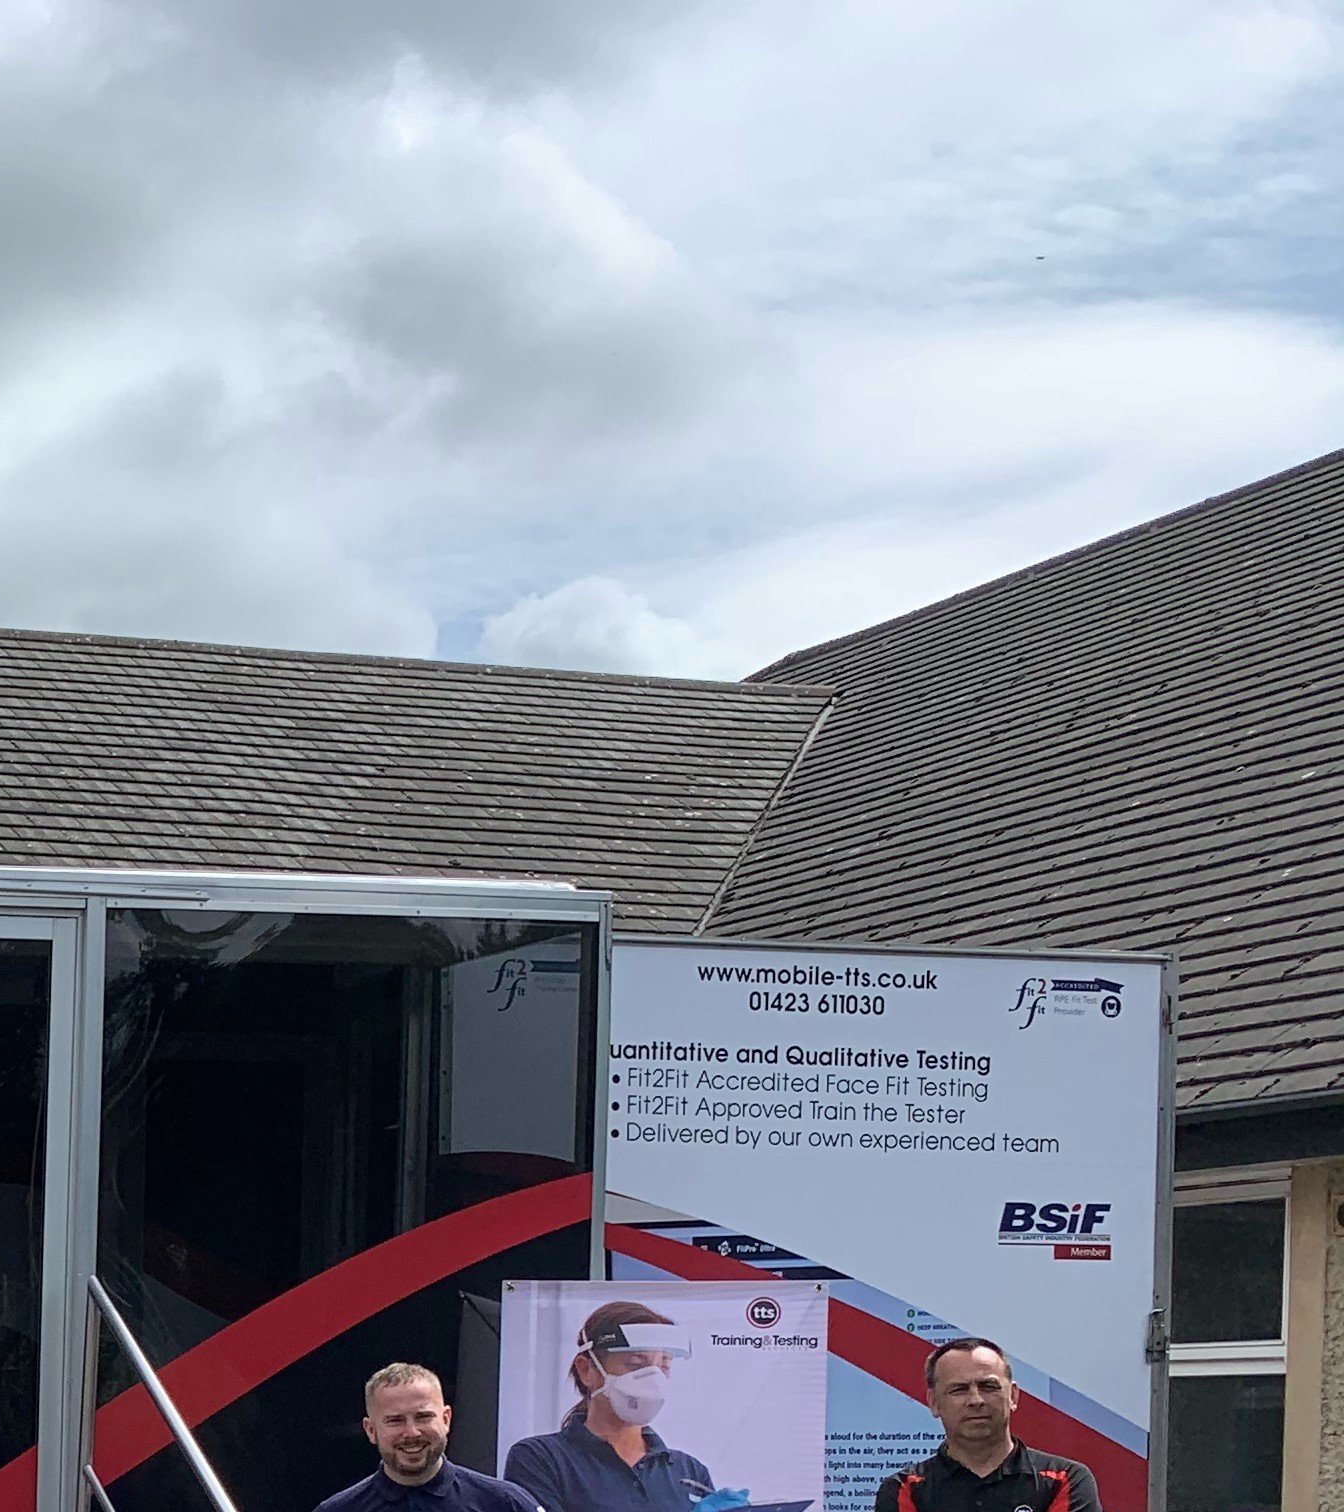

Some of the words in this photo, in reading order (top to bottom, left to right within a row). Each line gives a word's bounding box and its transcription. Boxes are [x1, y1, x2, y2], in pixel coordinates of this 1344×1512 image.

[697, 964, 938, 990] www.mobile-tts.co.uk
[749, 991, 810, 1013] 01423
[817, 994, 885, 1016] 611030
[609, 1041, 729, 1063] uantitative
[736, 1045, 779, 1064] and
[786, 1045, 909, 1069] Qualitative
[916, 1049, 991, 1076] Testing
[627, 1067, 689, 1089] Fit2Fit
[695, 1069, 820, 1093] Accredited
[826, 1073, 880, 1095] Face
[886, 1075, 910, 1096] Fit
[916, 1076, 989, 1103] Testing
[627, 1094, 689, 1116] Fit2Fit
[694, 1097, 802, 1122] Approved
[809, 1100, 856, 1121] Train
[863, 1102, 898, 1123] the
[904, 1103, 966, 1124] Tester
[626, 1121, 729, 1144] Delivered
[735, 1125, 762, 1150] by
[768, 1130, 802, 1147] our
[808, 1131, 853, 1148] own
[859, 1131, 996, 1153] experienced
[1002, 1133, 1059, 1153] team
[999, 1202, 1111, 1234] BSiF
[1071, 1246, 1107, 1258] Member
[753, 1306, 776, 1319] tts
